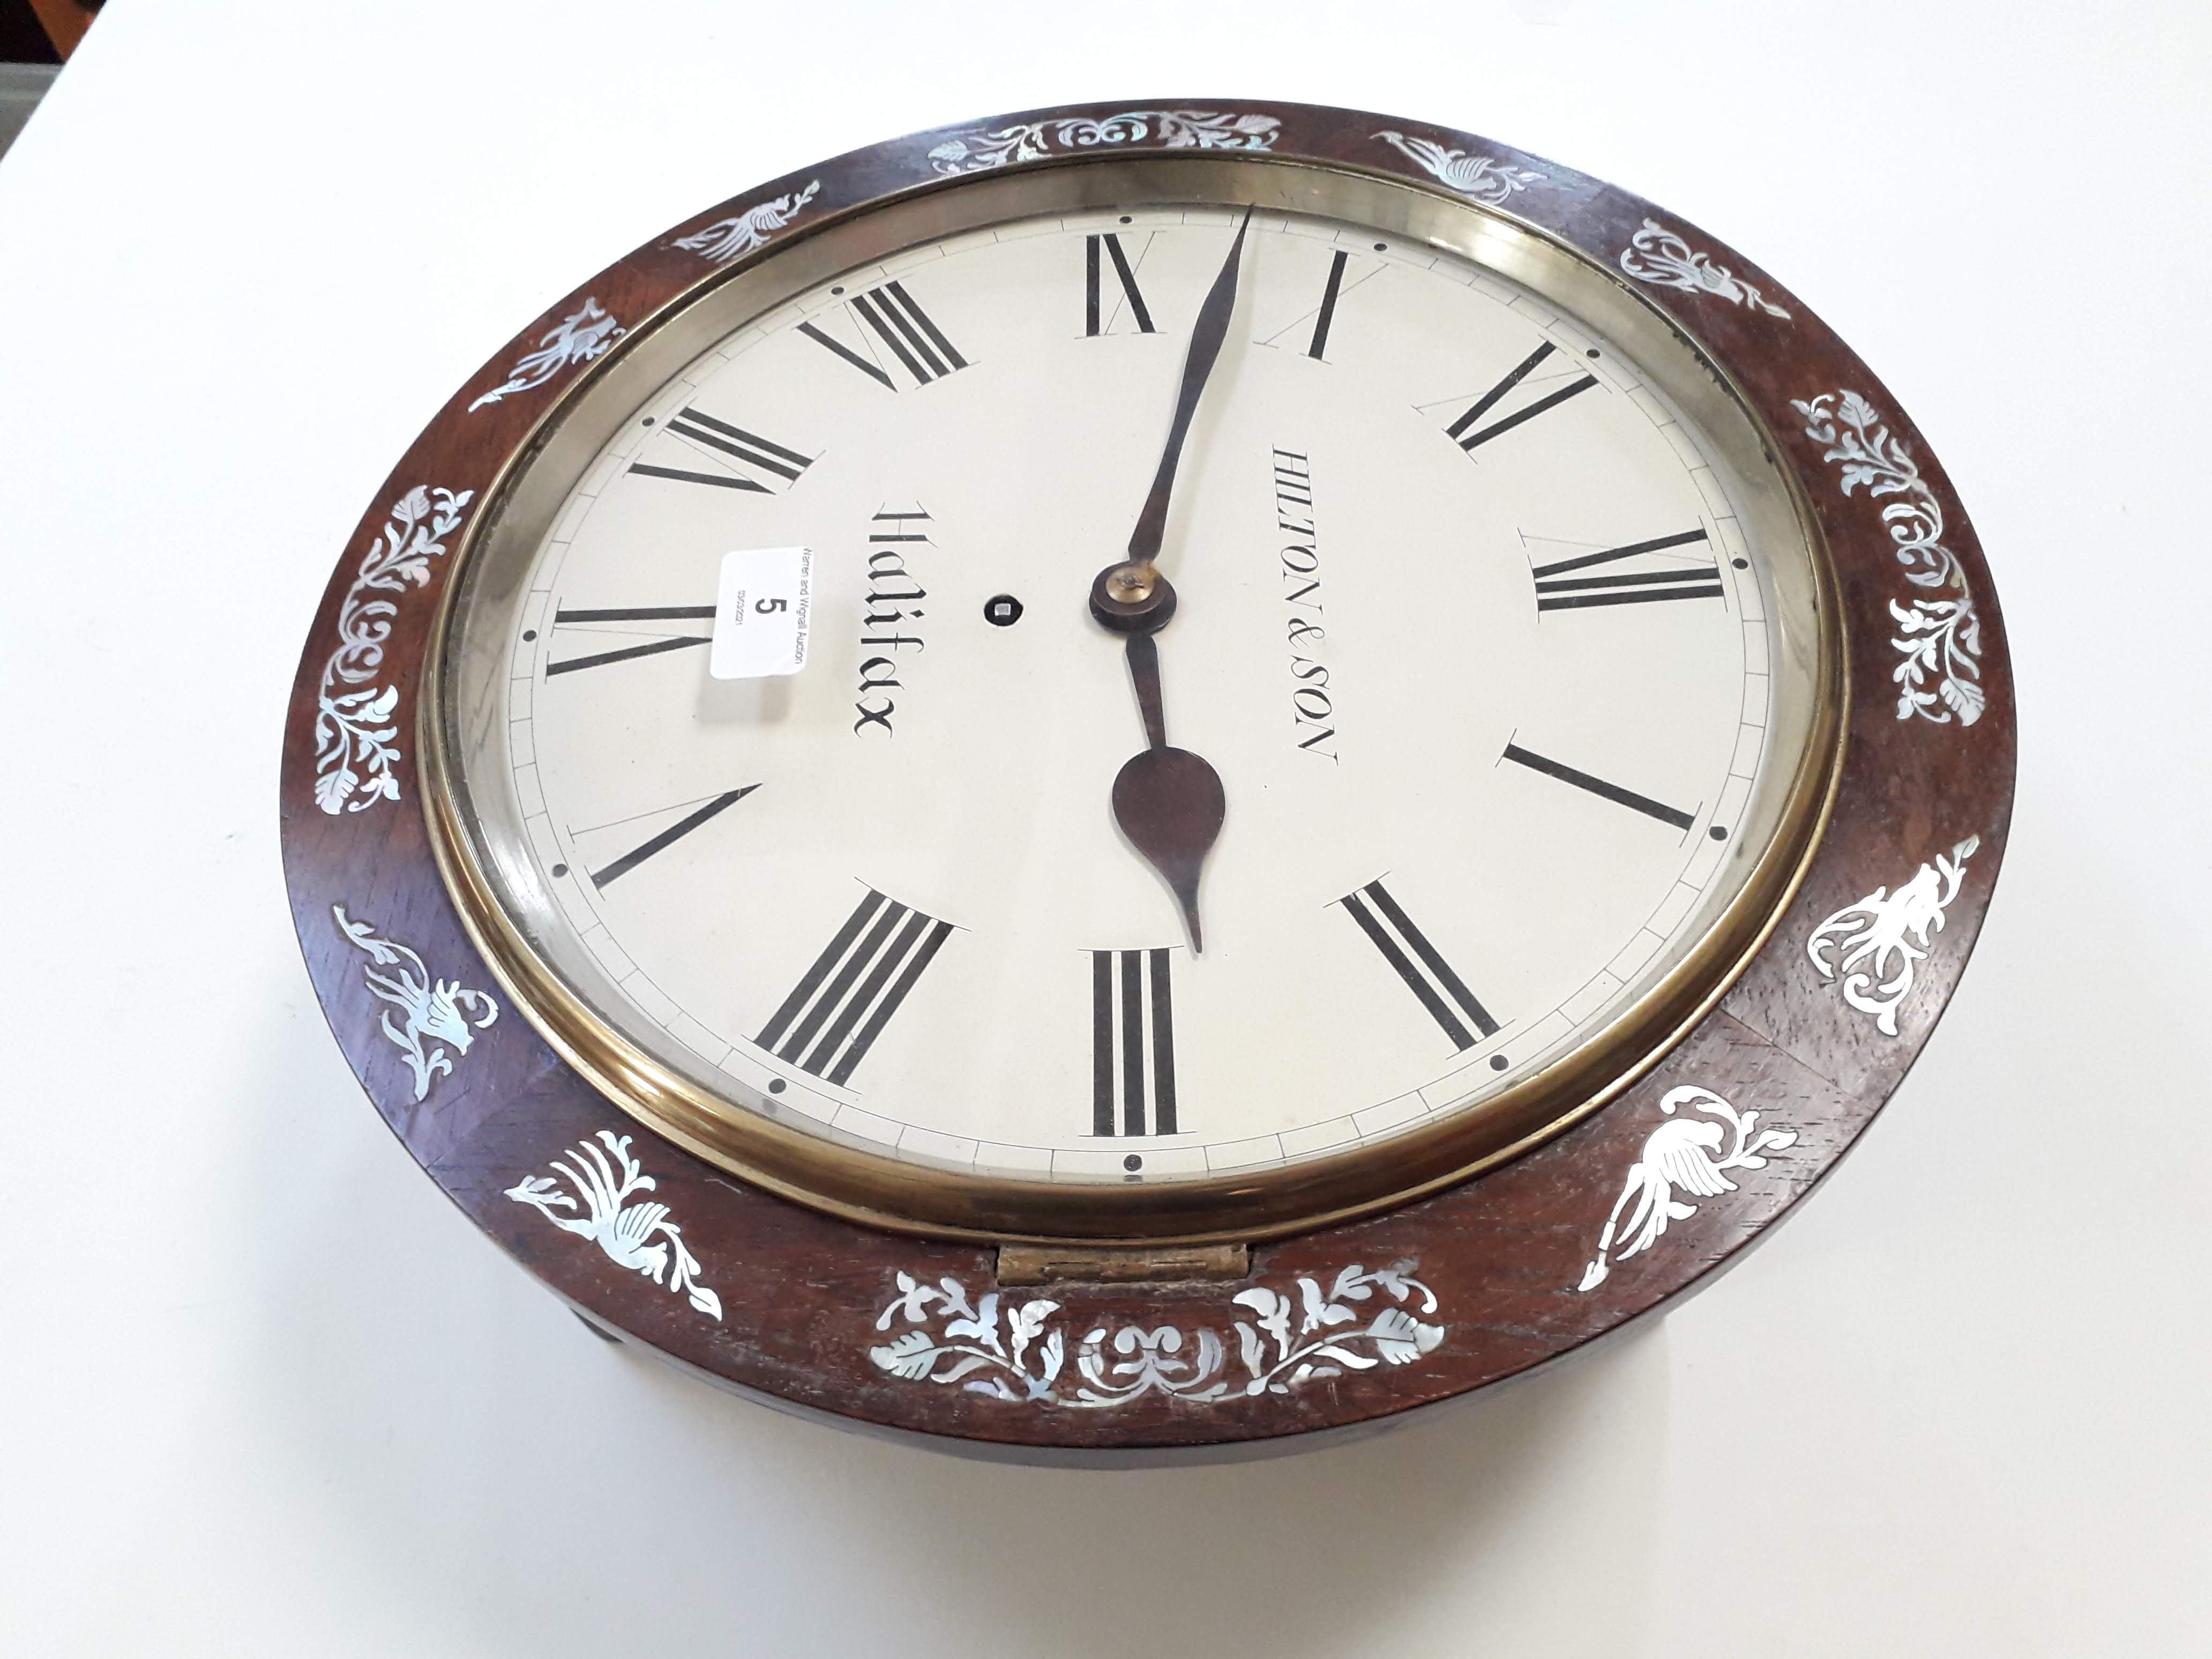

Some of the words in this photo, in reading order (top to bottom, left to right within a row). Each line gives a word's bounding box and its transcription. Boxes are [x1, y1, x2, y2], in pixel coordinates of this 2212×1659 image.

[791, 274, 981, 393] VIII
[1253, 248, 1389, 365] X
[622, 397, 826, 495] VII
[1413, 334, 1612, 465] XI
[801, 547, 812, 577] Warren
[1272, 443, 1324, 616] HILTON
[1517, 515, 1728, 624] XII
[754, 598, 788, 614] 5
[796, 597, 809, 629] Wignall
[800, 579, 809, 595] and
[854, 501, 938, 739] Halifax
[1288, 617, 1325, 649] &
[795, 631, 807, 664] Auction
[1290, 655, 1339, 766] SON
[566, 782, 763, 901] V
[741, 876, 971, 1095] IIII
[1323, 871, 1515, 1060] II
[1078, 945, 1197, 1137] III
